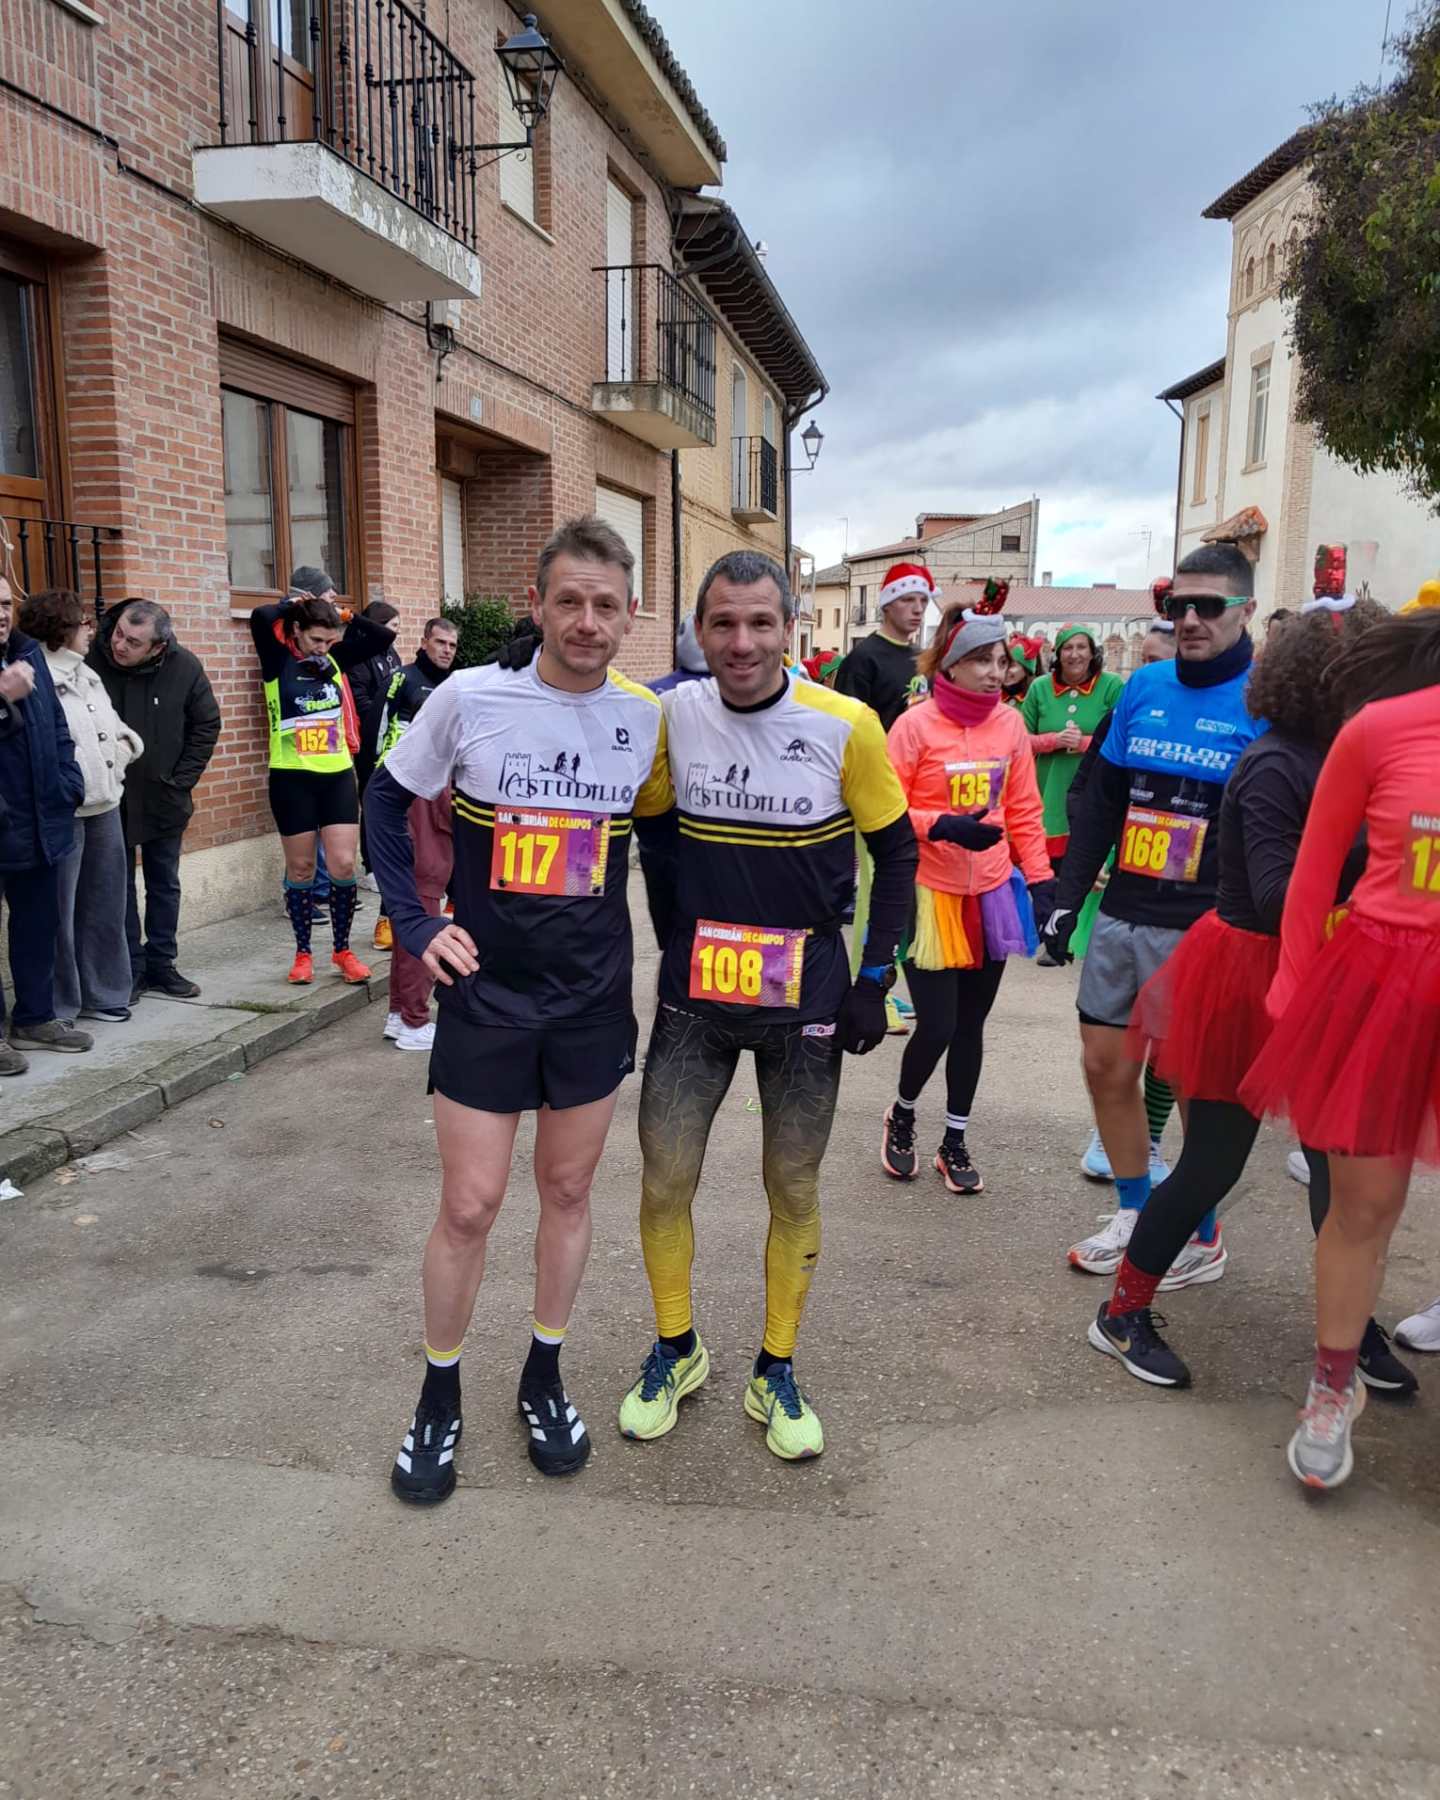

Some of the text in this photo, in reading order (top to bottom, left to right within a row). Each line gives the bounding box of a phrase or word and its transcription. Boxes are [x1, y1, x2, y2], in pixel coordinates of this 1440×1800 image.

[299, 728, 328, 751] 152
[950, 772, 990, 807] 135
[500, 831, 560, 885] 117
[1125, 825, 1171, 871] 168
[698, 944, 763, 997] 108
